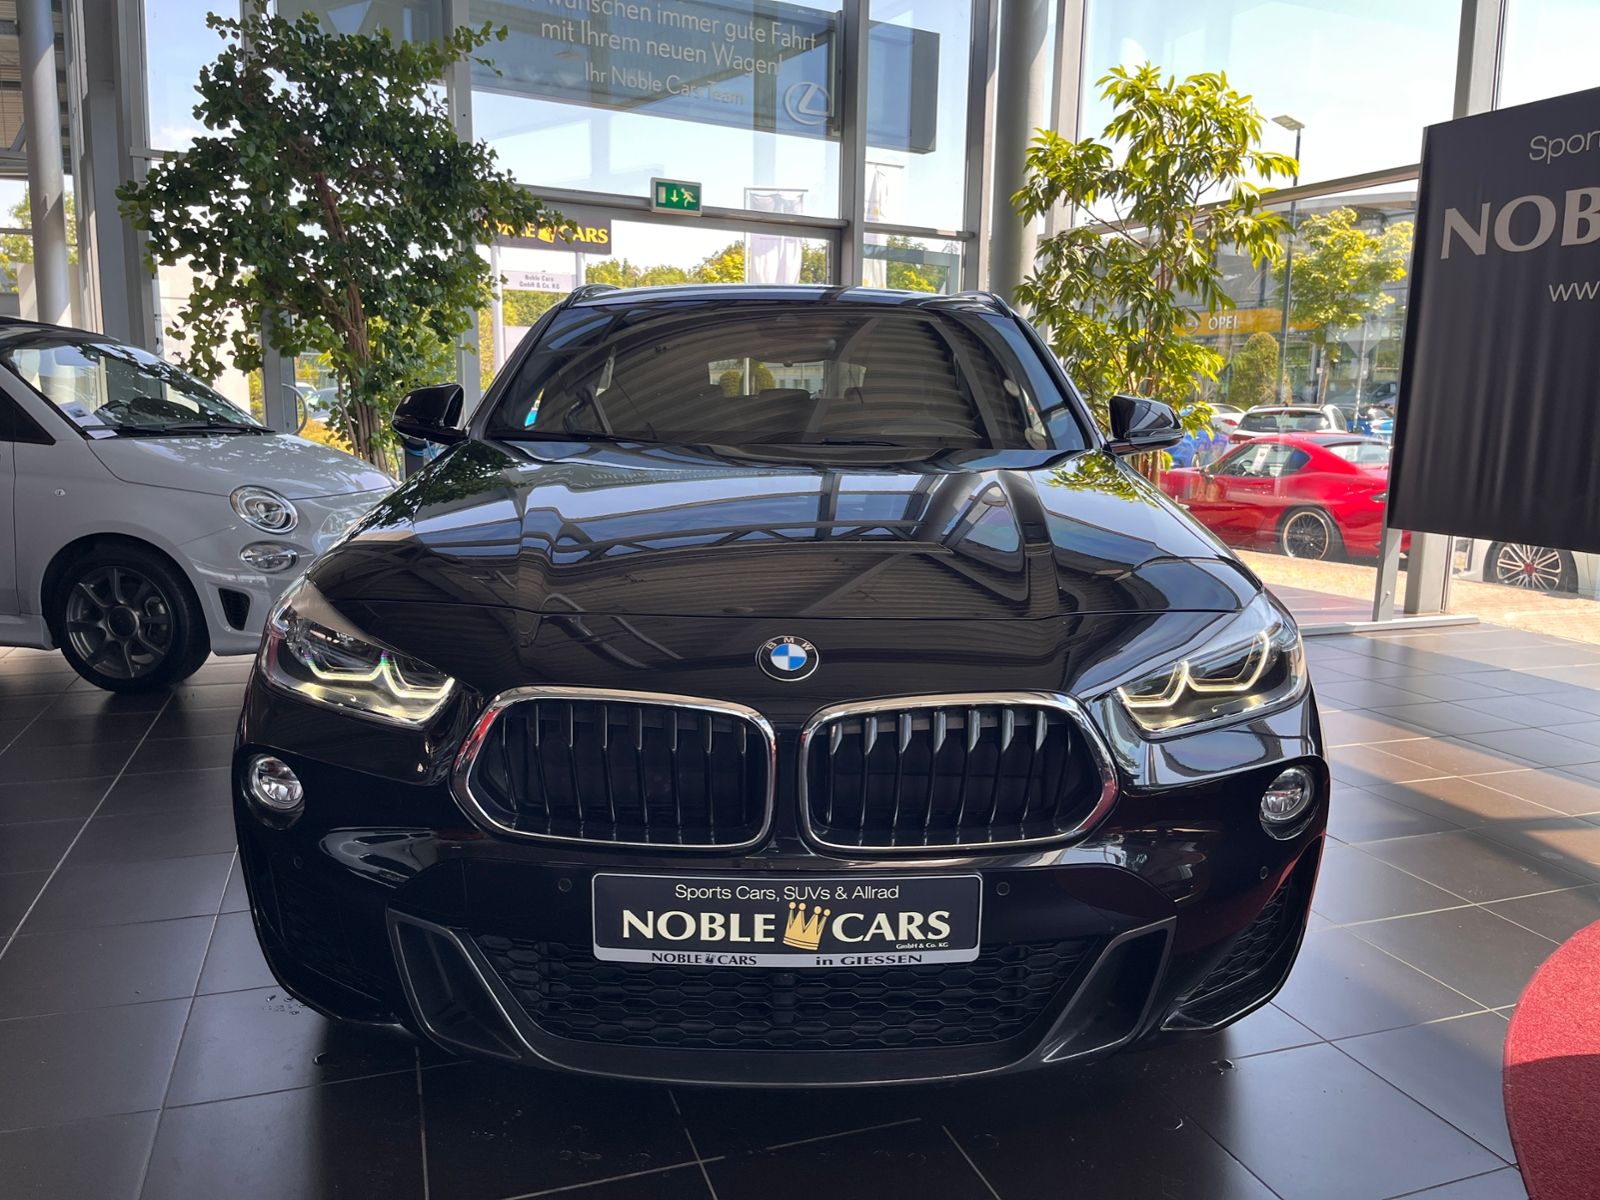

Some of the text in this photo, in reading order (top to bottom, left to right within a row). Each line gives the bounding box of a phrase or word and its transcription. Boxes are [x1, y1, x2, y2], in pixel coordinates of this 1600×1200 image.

[541, 20, 574, 42] mit
[581, 20, 641, 53] Ihrem
[646, 40, 707, 64] neuen
[657, 4, 720, 34] immer
[724, 22, 767, 42] gute
[771, 22, 816, 51] Fahrt
[585, 62, 607, 83] Ihr
[611, 65, 662, 92] Noble
[666, 74, 705, 97] Cars
[1529, 131, 1600, 164] Spor
[1440, 187, 1600, 260] NOB
[765, 636, 813, 651] BMW
[675, 884, 899, 902] Sports Cars, SUVs & Allrad
[622, 909, 951, 943] NOBLE CARS
[651, 952, 757, 966] NOBLE CARS
[816, 954, 923, 966] in GIESSEN
